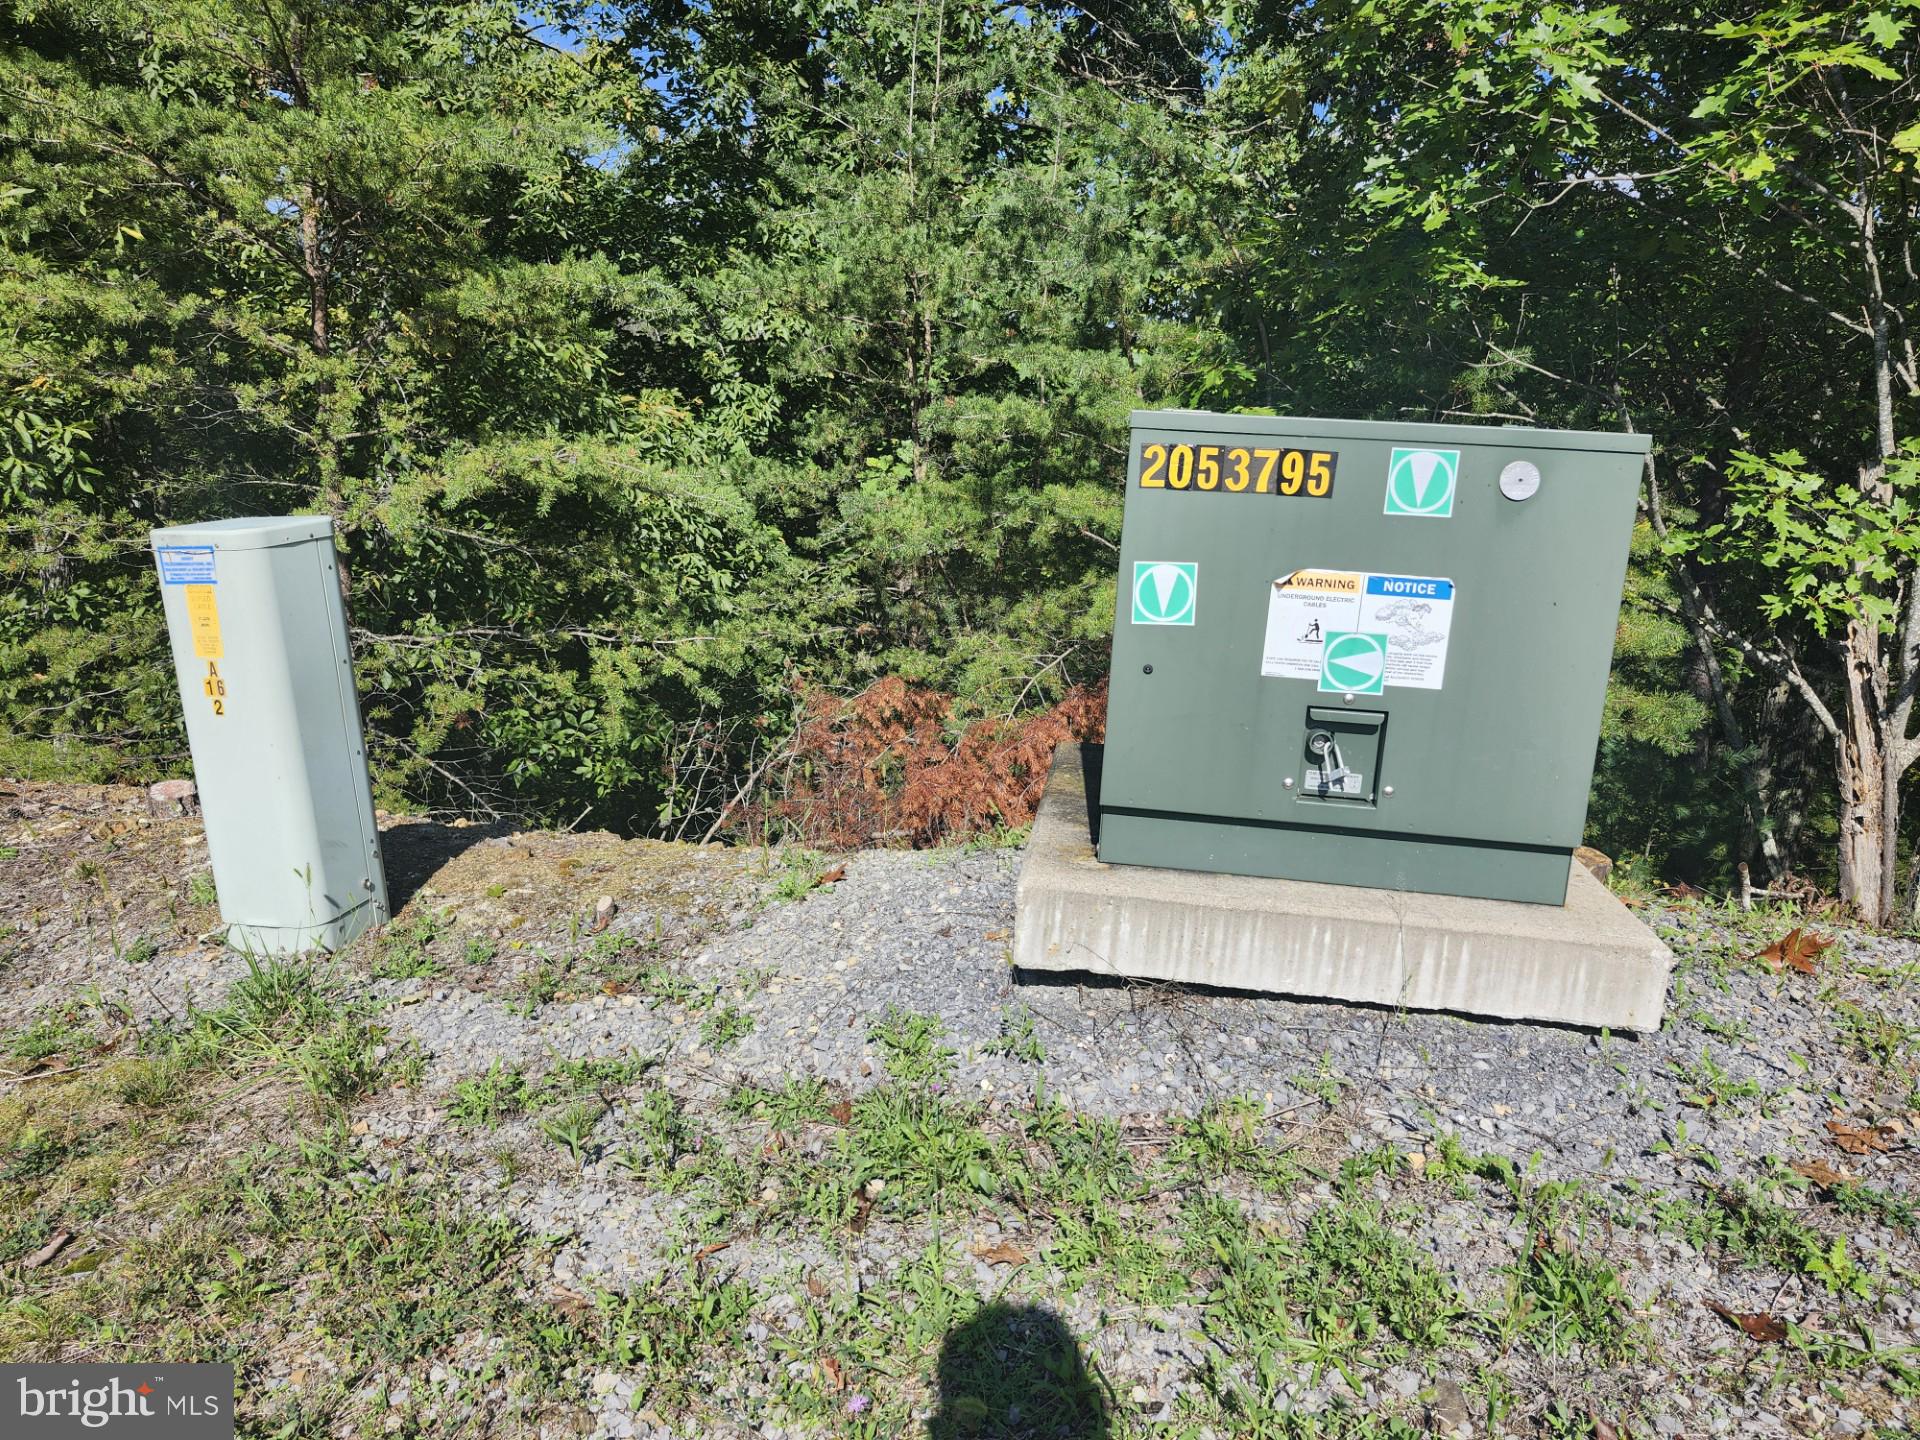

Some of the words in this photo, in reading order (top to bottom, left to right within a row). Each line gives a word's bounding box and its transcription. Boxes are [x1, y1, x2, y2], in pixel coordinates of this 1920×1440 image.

[1140, 444, 1332, 497] 2053795
[1296, 576, 1356, 590] WARNING
[1383, 579, 1437, 595] NOTICE
[1278, 592, 1325, 602] UNDERGROUND
[1325, 595, 1356, 604] ELECTRIC
[1303, 601, 1327, 609] CABLES
[209, 661, 218, 677] A
[206, 679, 225, 696] 16
[214, 700, 224, 716] 2
